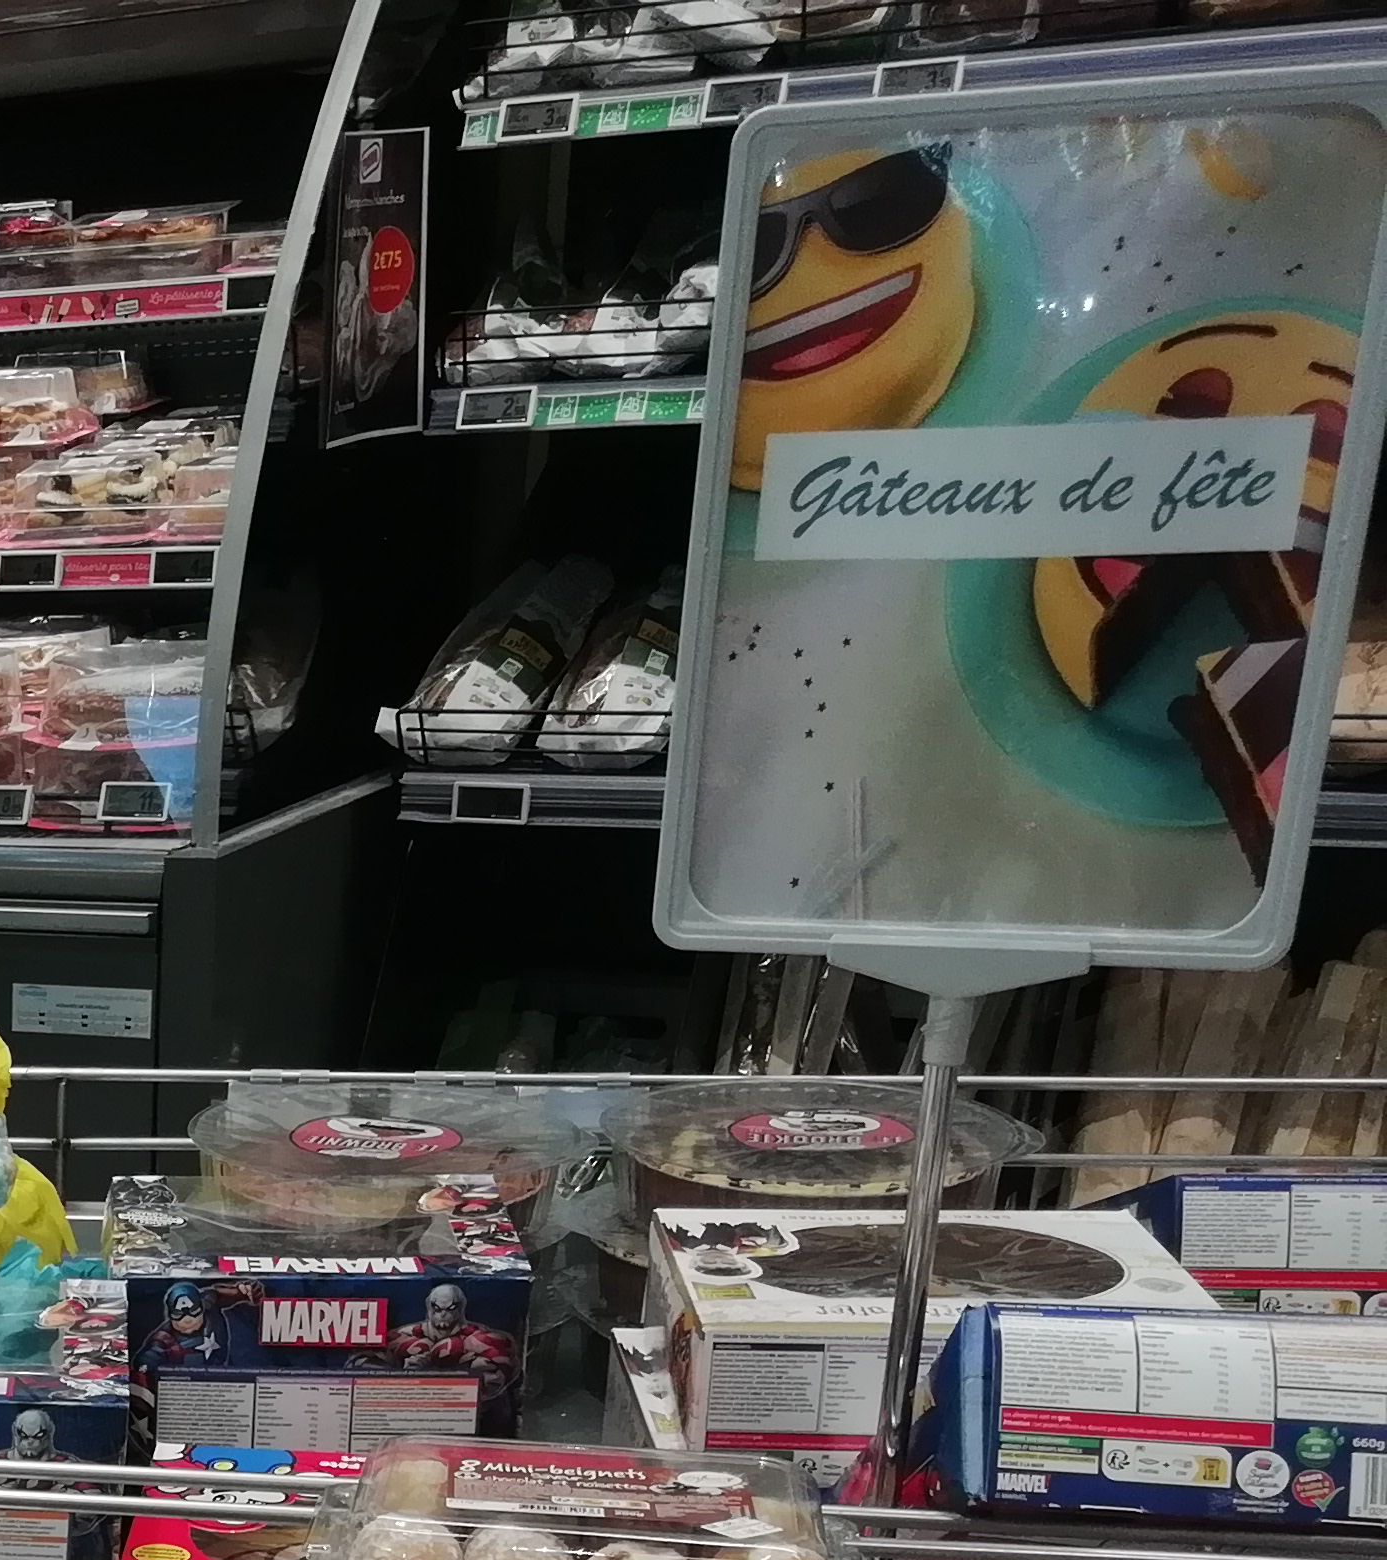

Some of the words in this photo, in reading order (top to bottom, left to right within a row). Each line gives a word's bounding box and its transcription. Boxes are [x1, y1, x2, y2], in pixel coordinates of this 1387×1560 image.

[790, 456, 1038, 539] Gâteaux
[1060, 457, 1135, 515] de
[1151, 450, 1275, 532] fête
[304, 1135, 407, 1151] BROWNIE
[223, 1256, 418, 1273] MARVEL
[261, 1300, 383, 1344] MARVEL
[459, 1459, 480, 1473] 8
[483, 1463, 647, 1482] Mini-beignets
[997, 1474, 1048, 1493] MARVEL
